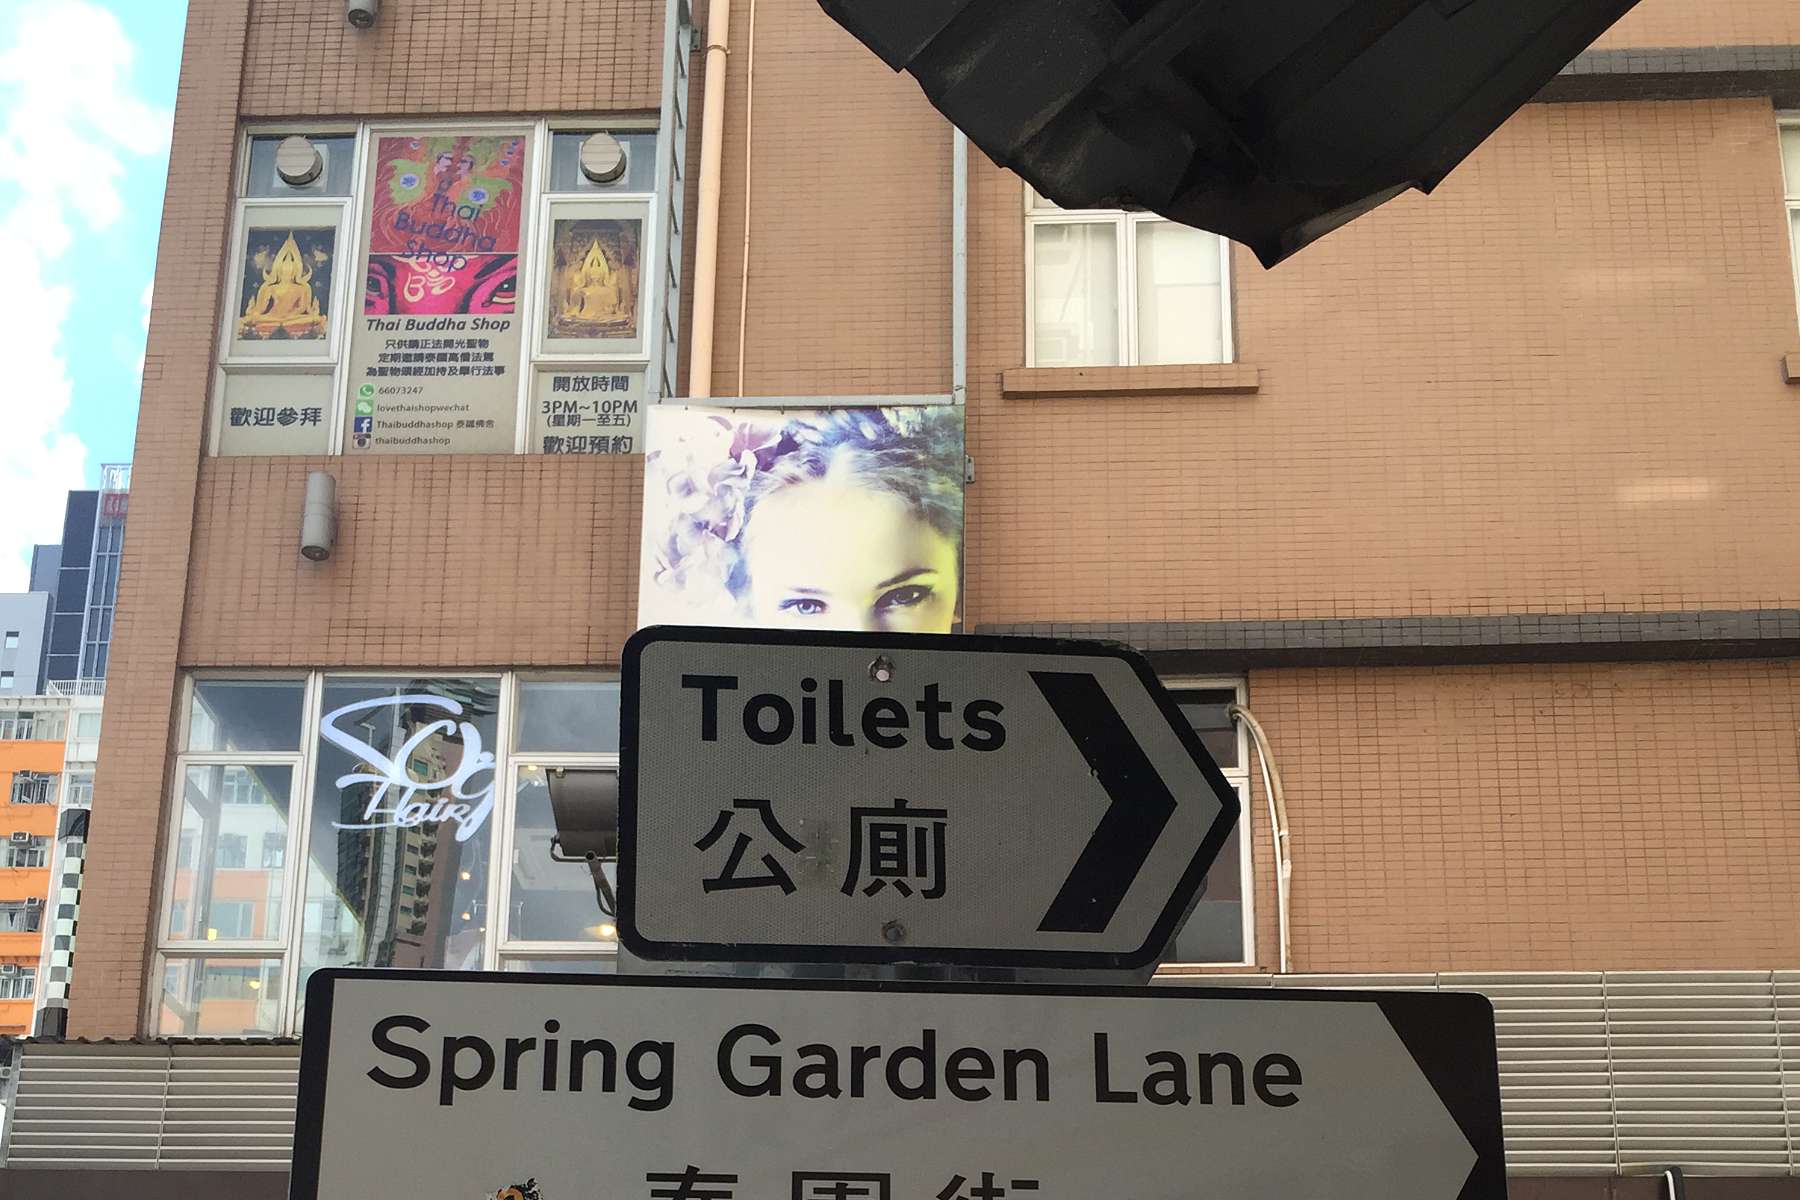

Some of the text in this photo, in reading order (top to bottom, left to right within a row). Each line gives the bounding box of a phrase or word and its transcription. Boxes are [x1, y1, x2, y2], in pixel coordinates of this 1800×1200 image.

[366, 318, 511, 332] Thai Buddha Shop
[553, 376, 629, 392] 開放時間
[230, 407, 322, 427] 歡迎參拜
[543, 435, 633, 455] 歡迎預約
[682, 674, 1007, 752] Toilets
[694, 798, 949, 900] 公廁
[368, 1014, 1302, 1110] Spring Garden Lane
